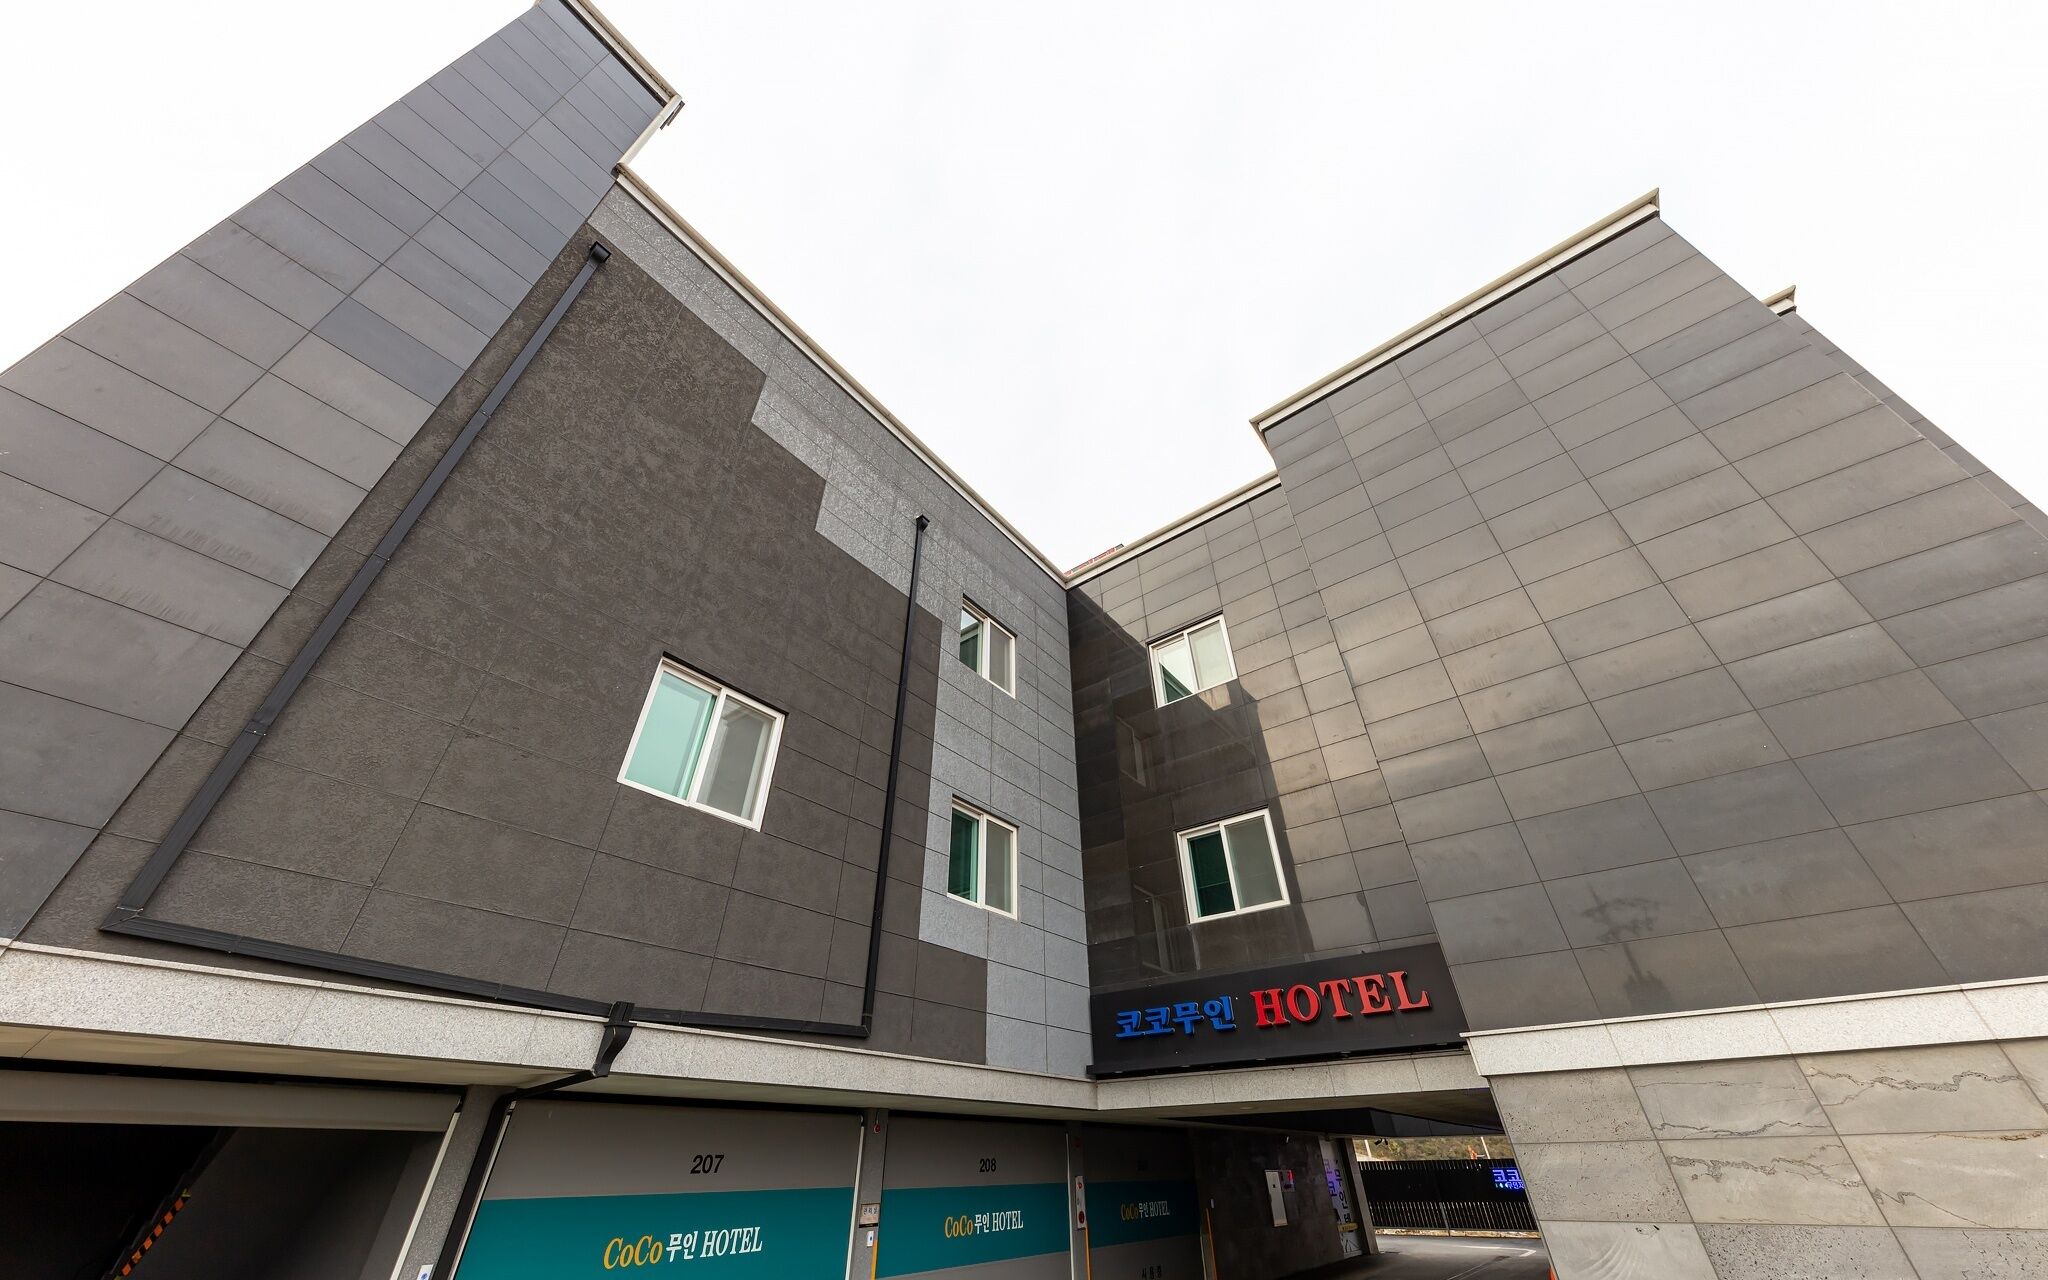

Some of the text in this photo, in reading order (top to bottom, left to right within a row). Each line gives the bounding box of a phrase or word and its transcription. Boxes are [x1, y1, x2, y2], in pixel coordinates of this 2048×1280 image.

[1115, 970, 1432, 1039] 코코무인 HOTEL
[690, 1154, 725, 1175] 207
[979, 1158, 997, 1173] 208
[1492, 1169, 1522, 1182] 코코
[1149, 1200, 1171, 1217] HOTEL
[944, 1210, 1024, 1239] CoCo 무인 HOTEL
[603, 1226, 764, 1270] CoCo 무인 HOTEL
